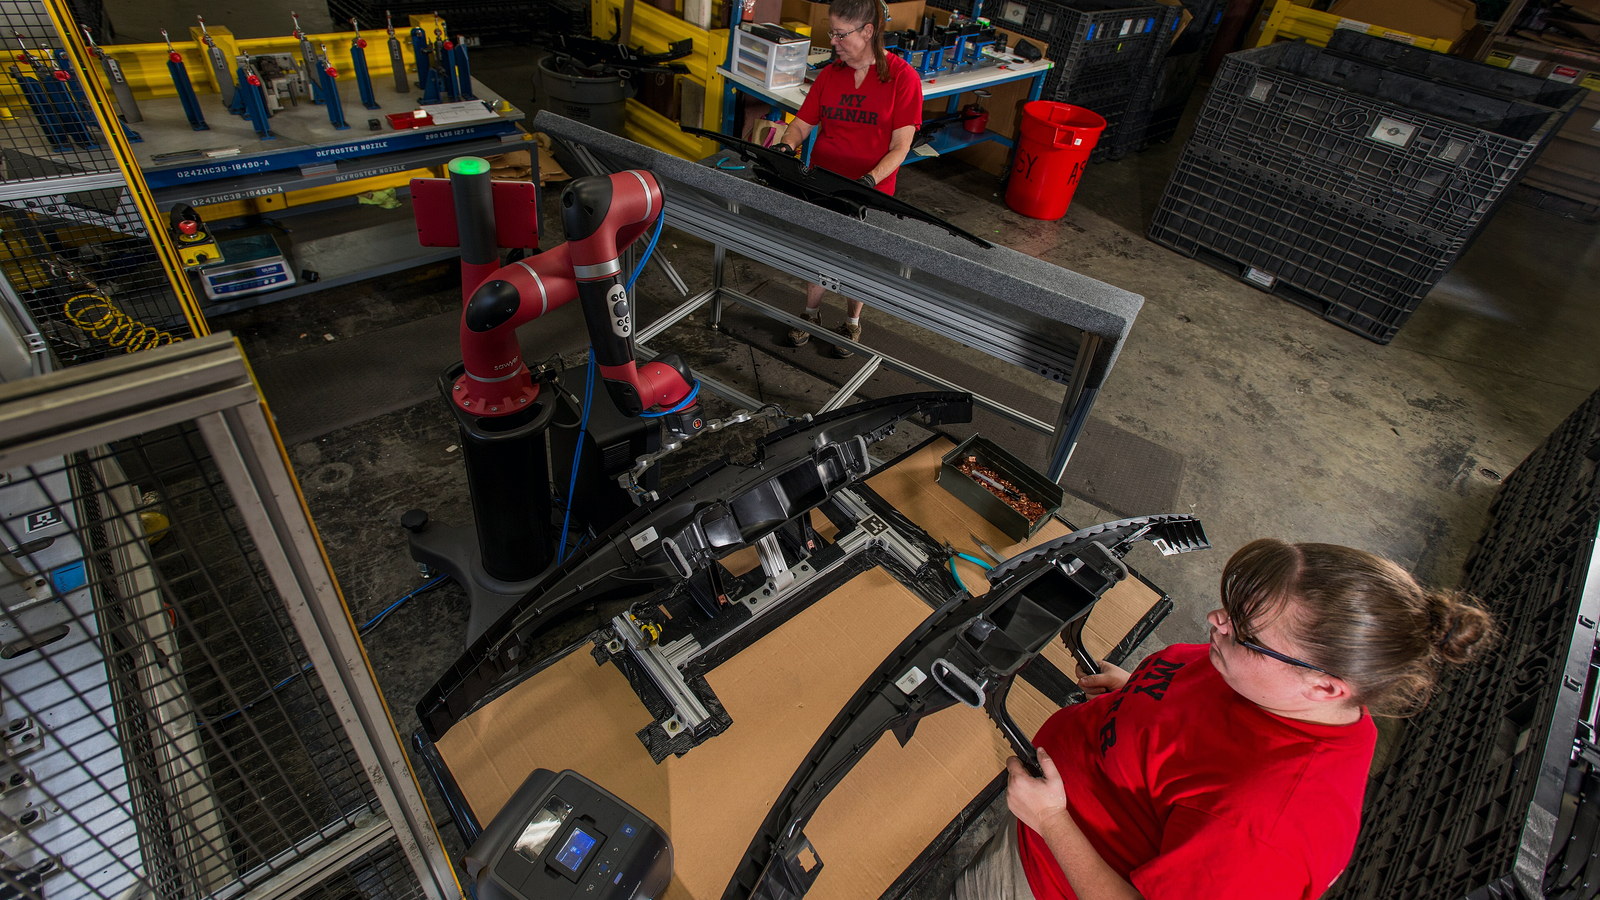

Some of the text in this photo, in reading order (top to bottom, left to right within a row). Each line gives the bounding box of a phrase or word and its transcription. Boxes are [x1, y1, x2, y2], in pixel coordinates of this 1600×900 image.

[839, 94, 867, 108] MY
[821, 105, 879, 125] MANAR
[316, 146, 358, 157] DEFROSTER
[361, 142, 389, 150] NOZZLE
[335, 170, 377, 182] DEFROSTER
[379, 165, 406, 174] NOZZLE
[494, 355, 519, 371] sawyer
[1134, 657, 1186, 701] MY
